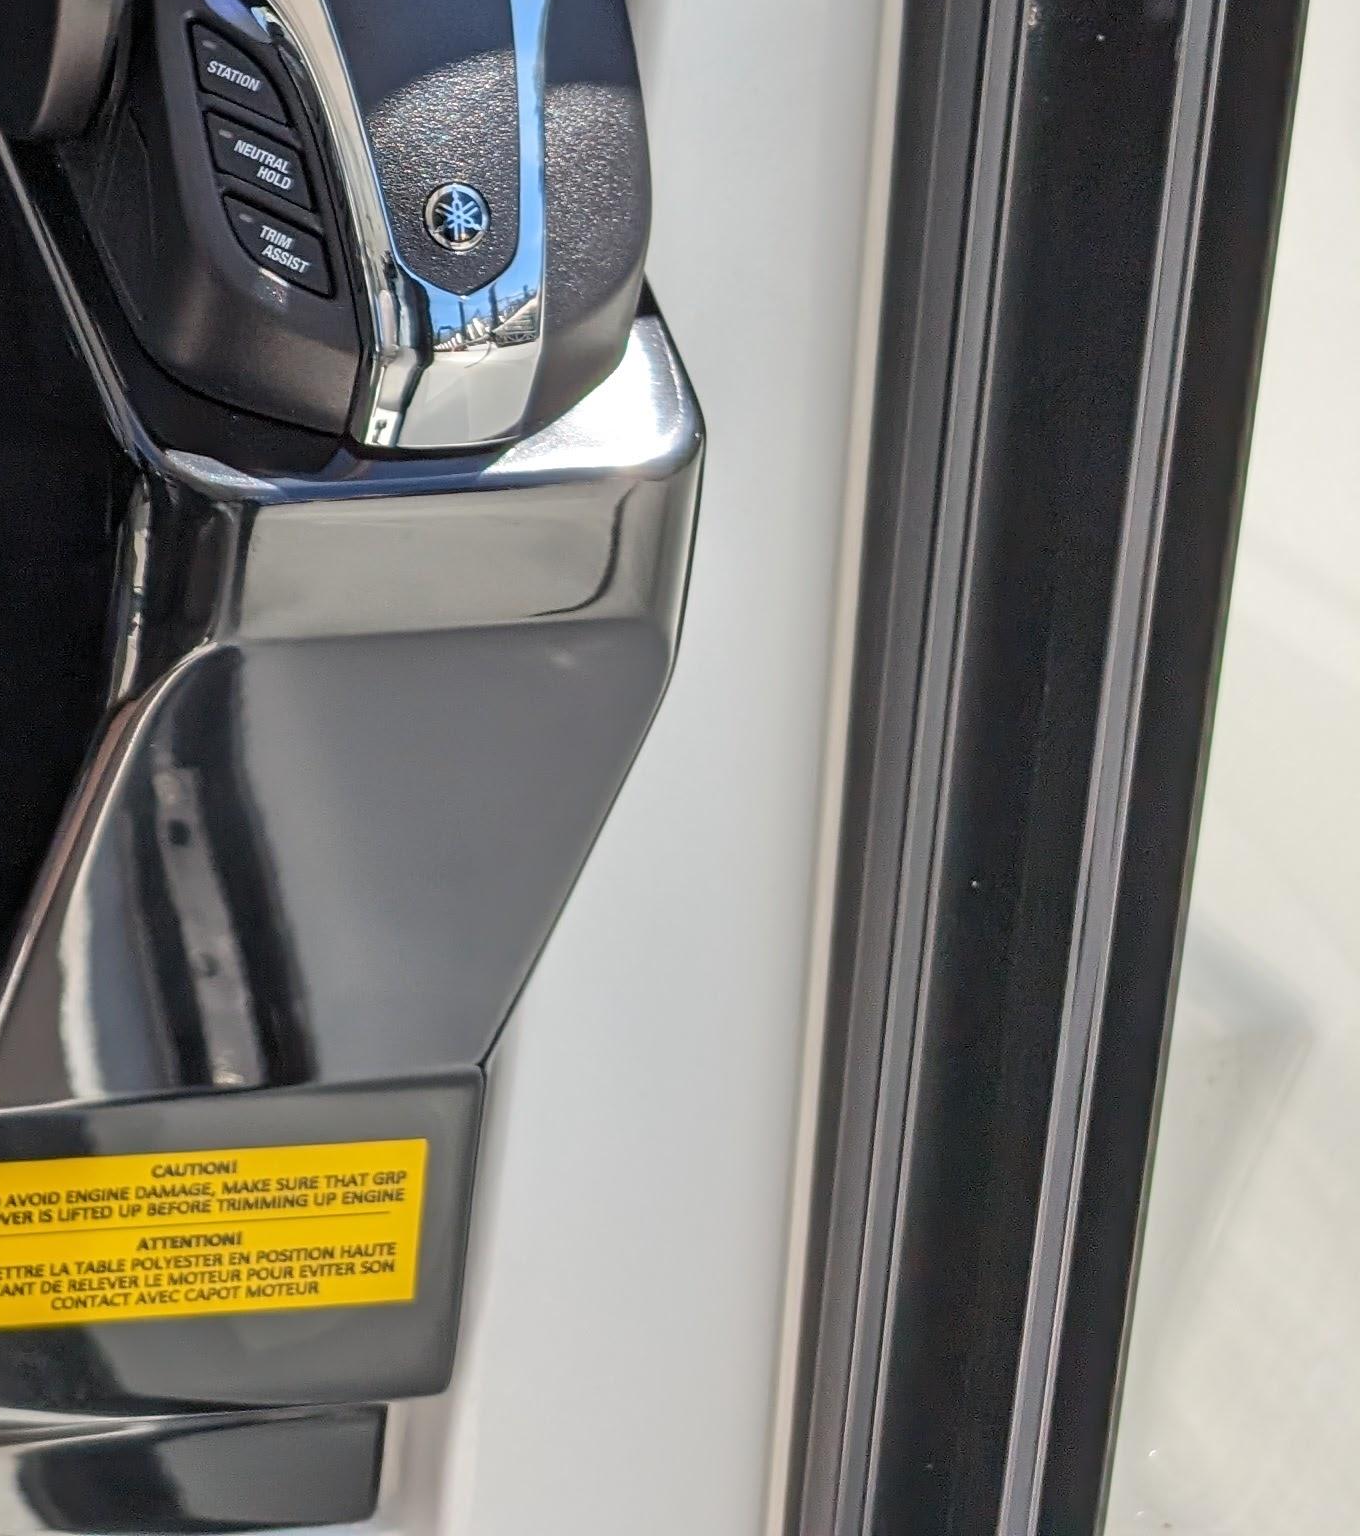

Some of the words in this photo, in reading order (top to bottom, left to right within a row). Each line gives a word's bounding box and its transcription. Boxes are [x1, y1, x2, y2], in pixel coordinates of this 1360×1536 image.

[206, 60, 261, 92] STATION
[233, 139, 290, 175] NEUTRAL
[256, 166, 292, 191] HOLD
[259, 224, 293, 250] TRIM
[261, 245, 311, 274] ASSIST
[150, 1159, 238, 1179] CAUTION!
[4, 1191, 61, 1209] AVOID
[65, 1186, 131, 1204] ENGINE
[134, 1181, 217, 1200] DAMAGE,
[221, 1178, 272, 1196] MAKE
[275, 1175, 320, 1192] SURE
[323, 1172, 369, 1189] THAT
[372, 1170, 408, 1186] GRP
[37, 1208, 52, 1224] IS
[57, 1205, 113, 1223] LIFTED
[118, 1203, 142, 1218] UP
[146, 1198, 212, 1217] BEFORE
[217, 1193, 308, 1213] TRIMMING
[313, 1191, 337, 1207] UP
[341, 1187, 405, 1205] ENGINE
[136, 1231, 243, 1252] ATTENTION!
[49, 1262, 69, 1277] LA
[73, 1258, 127, 1275] TABLE
[130, 1252, 223, 1272] POLYESTER
[228, 1251, 251, 1266] EN
[255, 1245, 336, 1264] POSITION
[339, 1241, 398, 1259] HAUTE
[39, 1279, 63, 1295] DE
[66, 1274, 140, 1293] RELEVER
[143, 1273, 163, 1288] LE
[166, 1268, 242, 1286] MOTEUR
[246, 1265, 294, 1282] POUR
[298, 1261, 356, 1278] EVITER
[359, 1259, 396, 1275] SON
[50, 1292, 131, 1311] CONTACT
[134, 1289, 181, 1306] AVEC
[184, 1286, 241, 1303] CAPOT
[245, 1281, 320, 1299] MOTEUR
